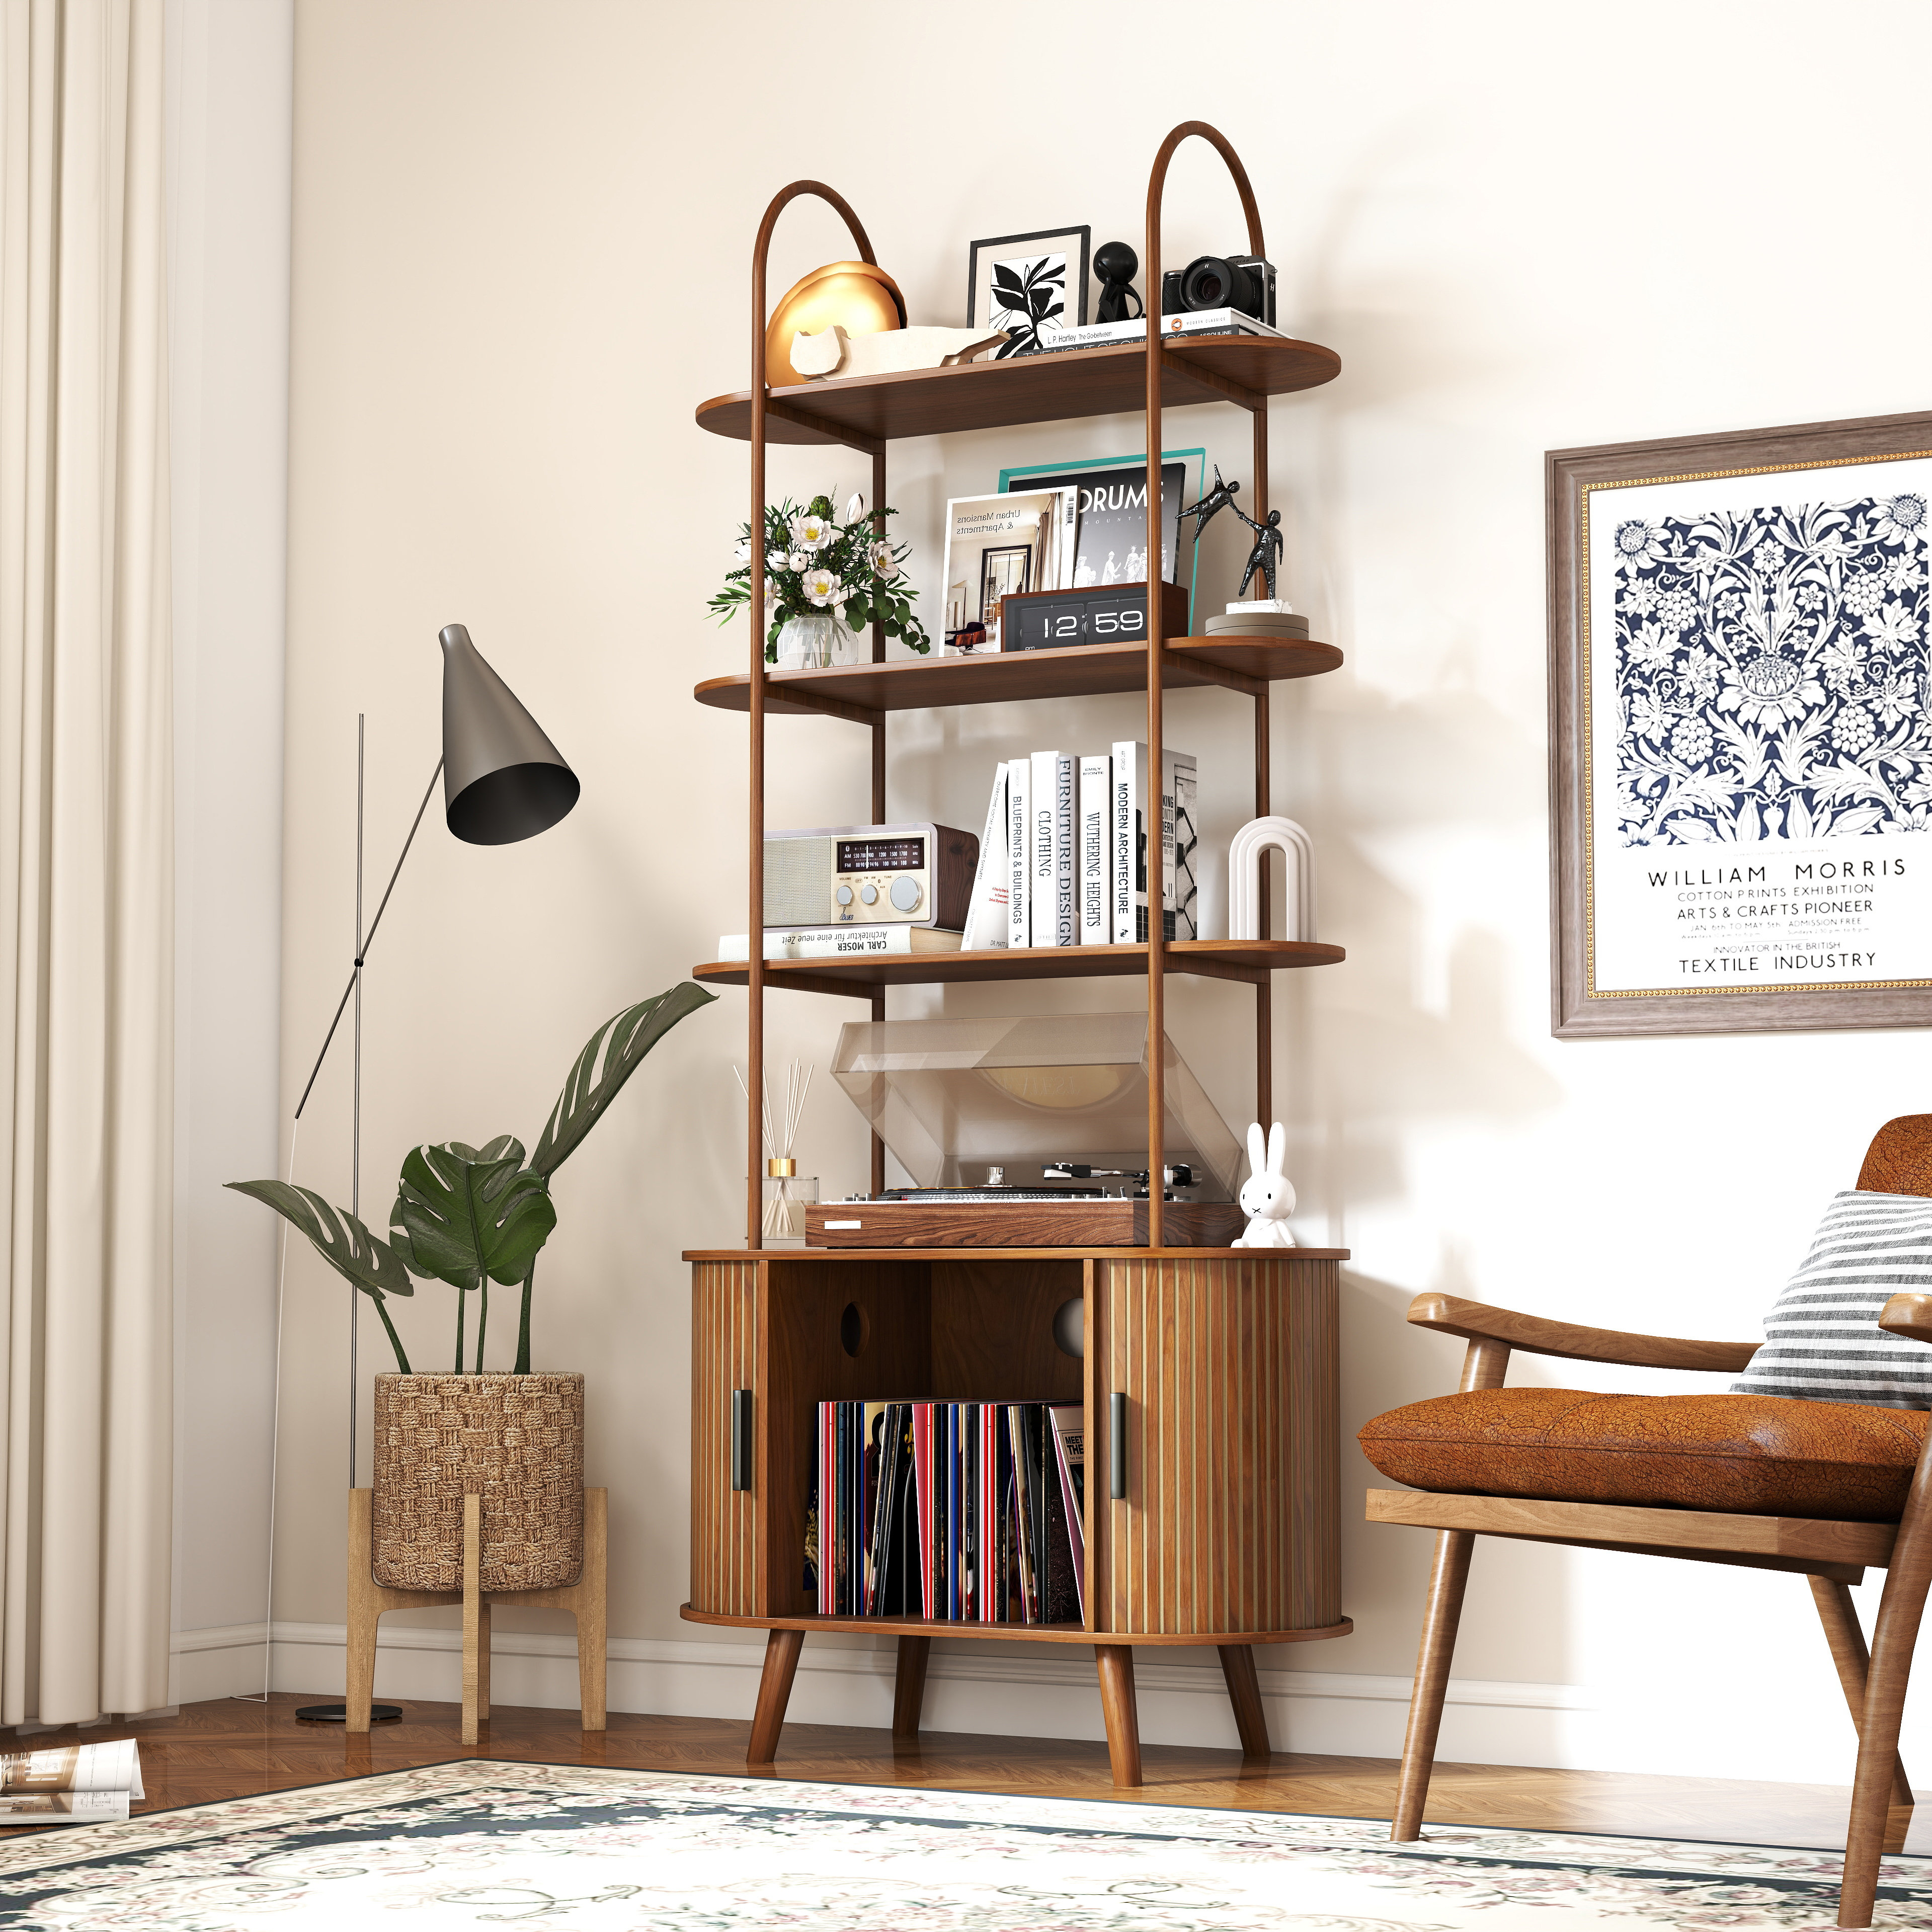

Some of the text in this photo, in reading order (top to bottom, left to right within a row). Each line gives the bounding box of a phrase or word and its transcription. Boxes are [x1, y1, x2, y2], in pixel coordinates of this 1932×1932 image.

[1059, 334, 1076, 342] Hartley
[1085, 516, 1147, 525] MOUNTA
[1044, 610, 1143, 638] 12 59
[1013, 796, 1021, 857] BLUEPRINTS
[1038, 811, 1051, 876] CLOTHING
[1118, 783, 1128, 914] MODERN ARCHITECTURE
[1060, 760, 1071, 946] FURNITURE DESIGN
[1087, 812, 1100, 927] WUTHERING HEIGHTS
[1648, 859, 1905, 887] WILLIAM MORRIS
[1013, 871, 1022, 924] BUILDINGS
[1678, 883, 1874, 902] COTTON PRINTS EXHIBITION
[1677, 900, 1873, 920] ARTS & CRAFTS PIONEER
[1789, 919, 1837, 927] ADMISSION
[782, 936, 796, 945] Zeit
[817, 934, 832, 942] eine
[834, 934, 845, 942] für
[847, 931, 888, 941] Architektur
[837, 941, 887, 951] CARL MOSER
[1714, 945, 1769, 953] INNOVATOR
[1806, 942, 1840, 950] BRITISH
[1679, 953, 1876, 973] TEXTILE INDUSTRY
[1065, 1436, 1083, 1444] MEET
[1067, 1444, 1084, 1455] THE
